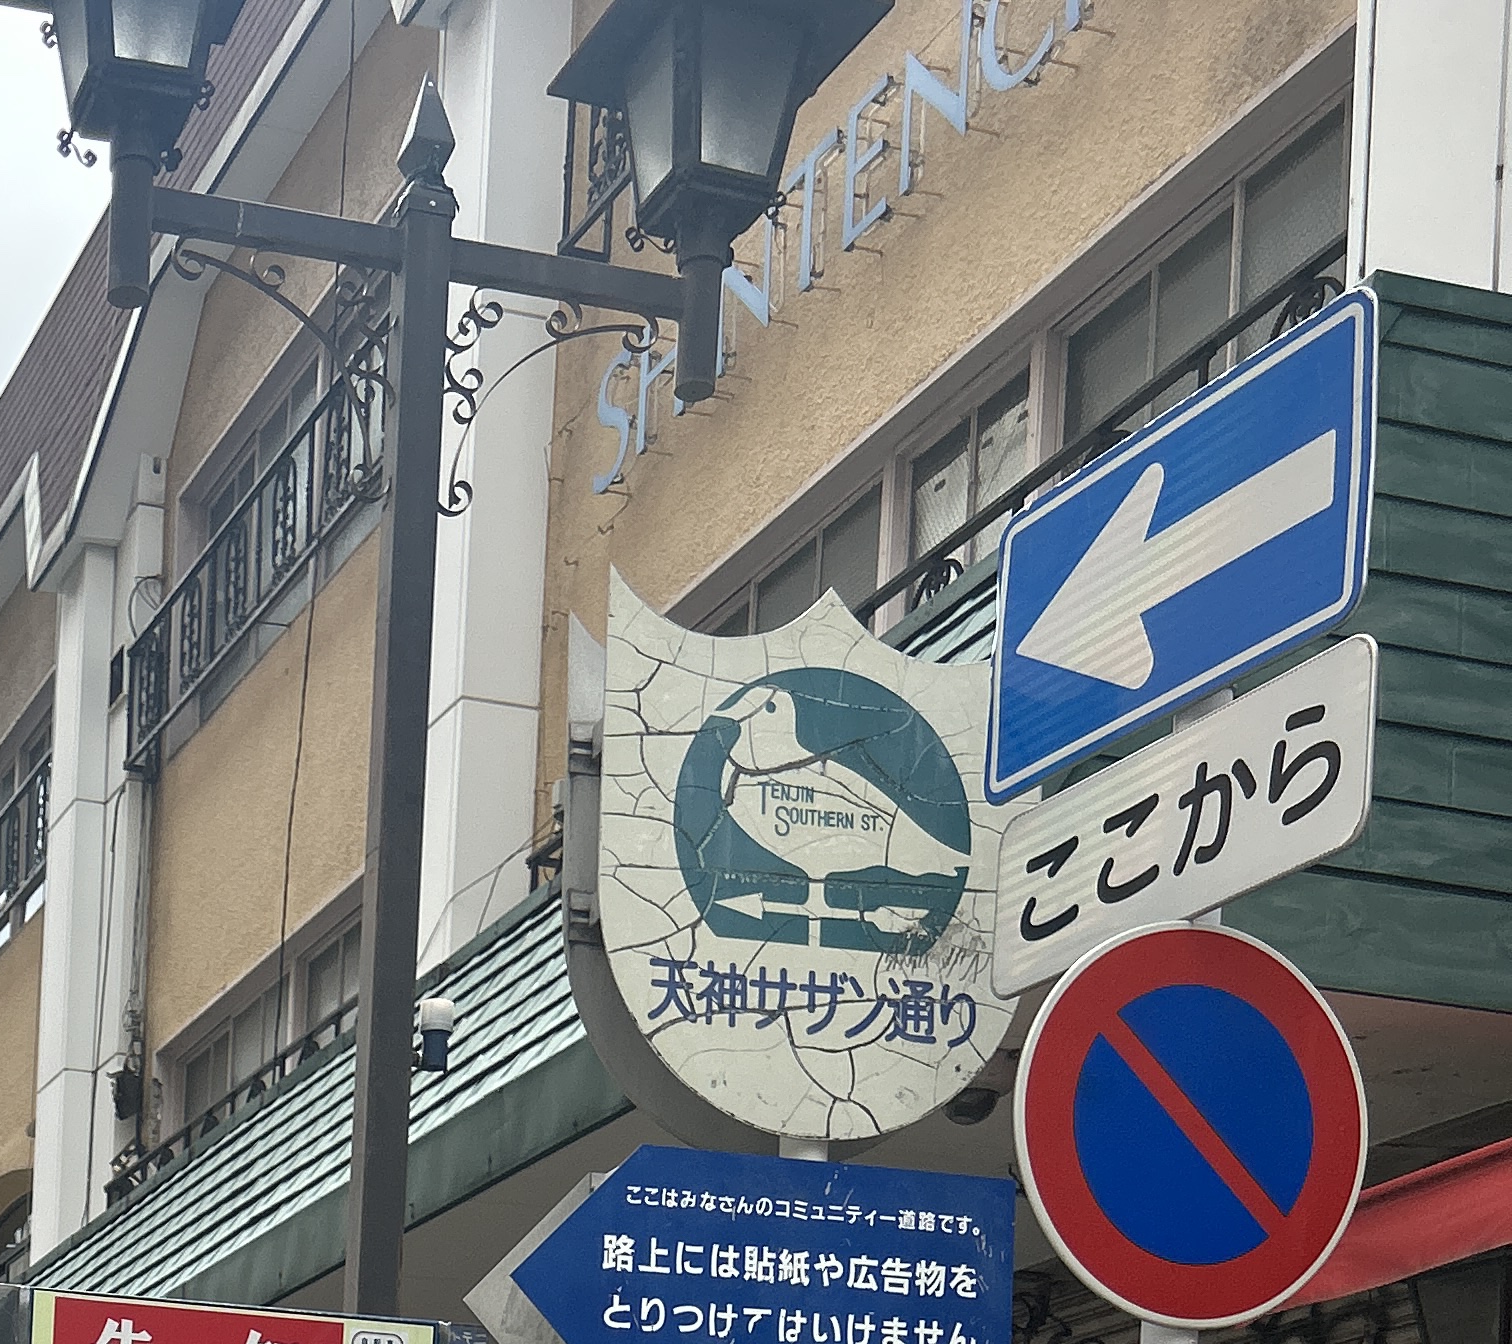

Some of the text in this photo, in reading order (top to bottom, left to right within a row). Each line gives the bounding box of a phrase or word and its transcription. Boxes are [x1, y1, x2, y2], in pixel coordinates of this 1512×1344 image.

[758, 780, 815, 815] TENJIN
[774, 805, 885, 836] SOUTHERN ST.
[1020, 704, 1342, 942] ここから
[648, 957, 976, 1048] 天神サザン通り
[626, 1185, 982, 1237] ここはみなさんのコミュニティー道路です。
[601, 1233, 979, 1300] 路上には貼紙や広告物を
